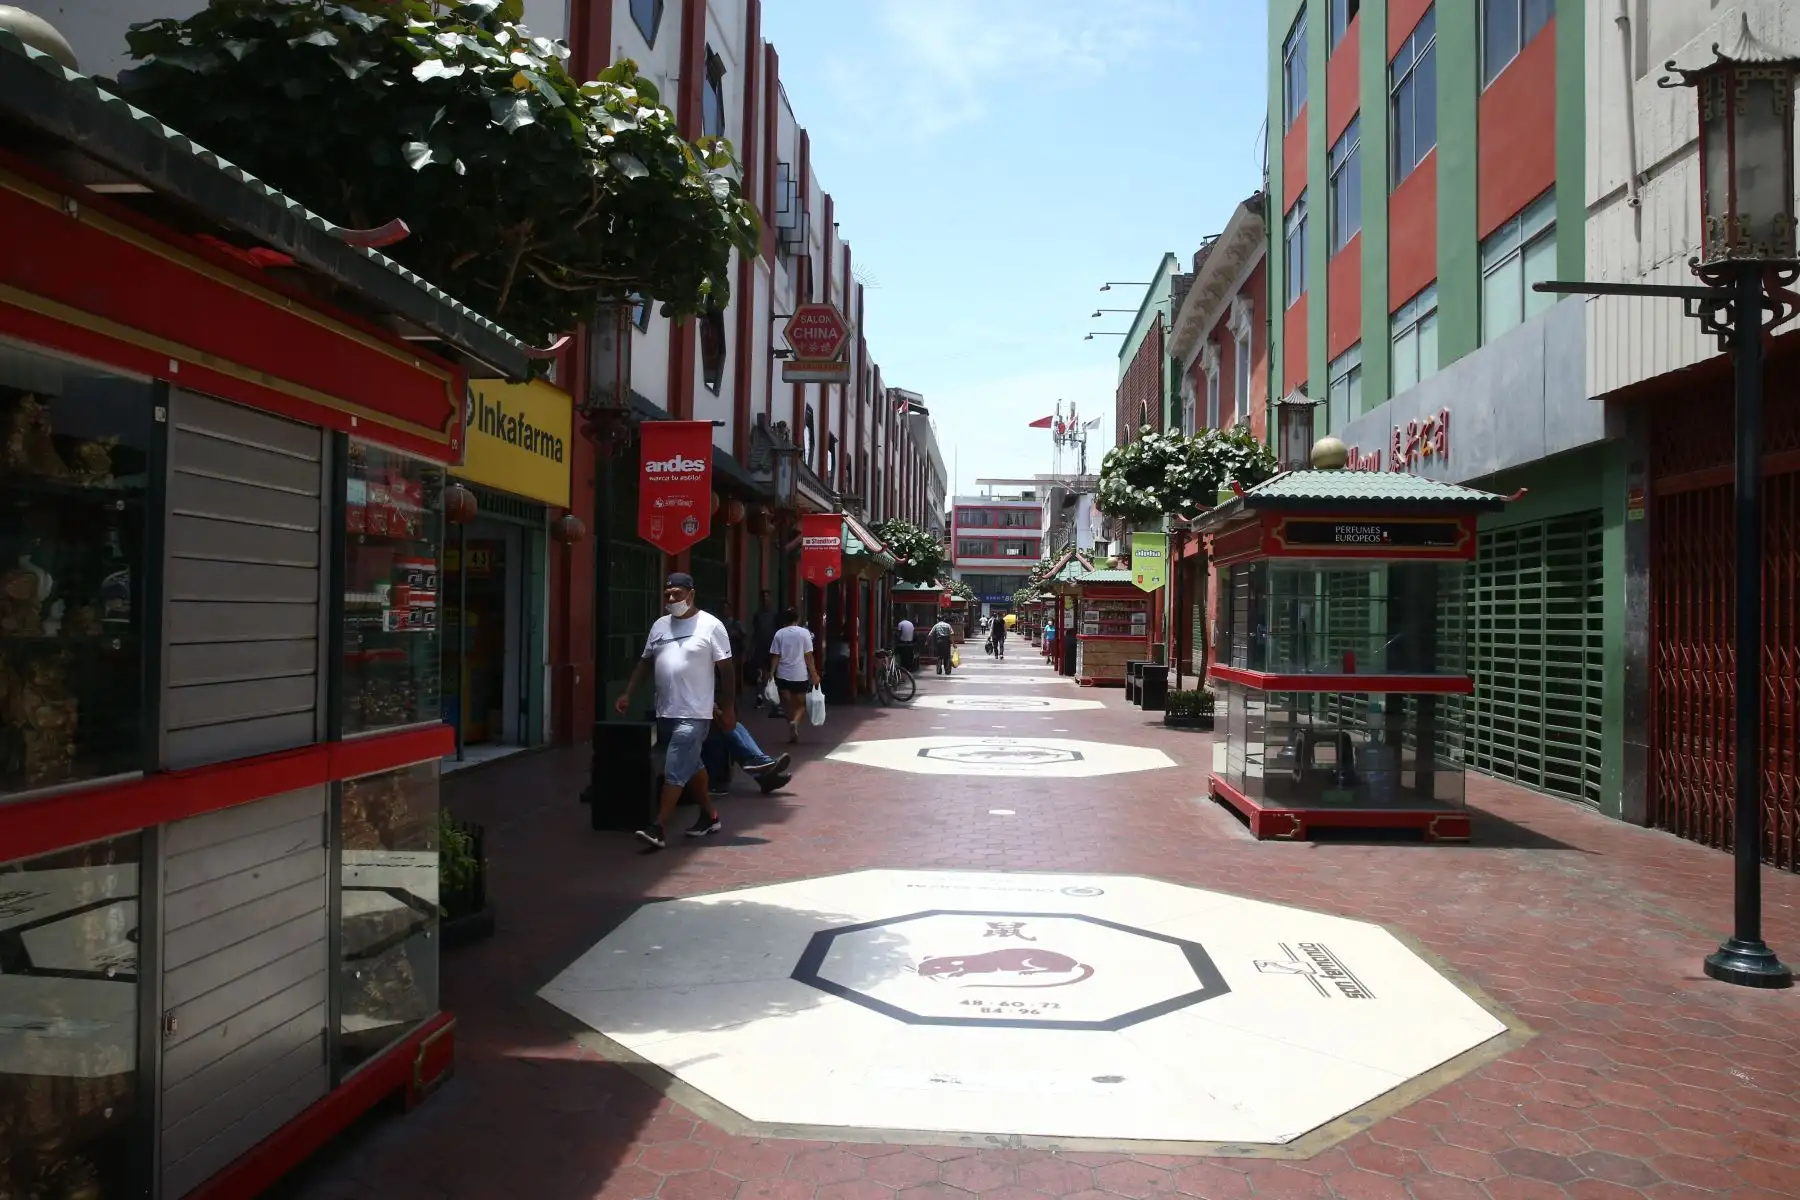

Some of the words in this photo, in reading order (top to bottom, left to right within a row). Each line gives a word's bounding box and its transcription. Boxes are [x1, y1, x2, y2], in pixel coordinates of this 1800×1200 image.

[793, 327, 838, 339] CHINA
[478, 392, 563, 464] Inkafarma
[645, 454, 705, 473] andes
[1335, 525, 1381, 534] PERFUMES
[1335, 534, 1381, 542] EUROPEOS
